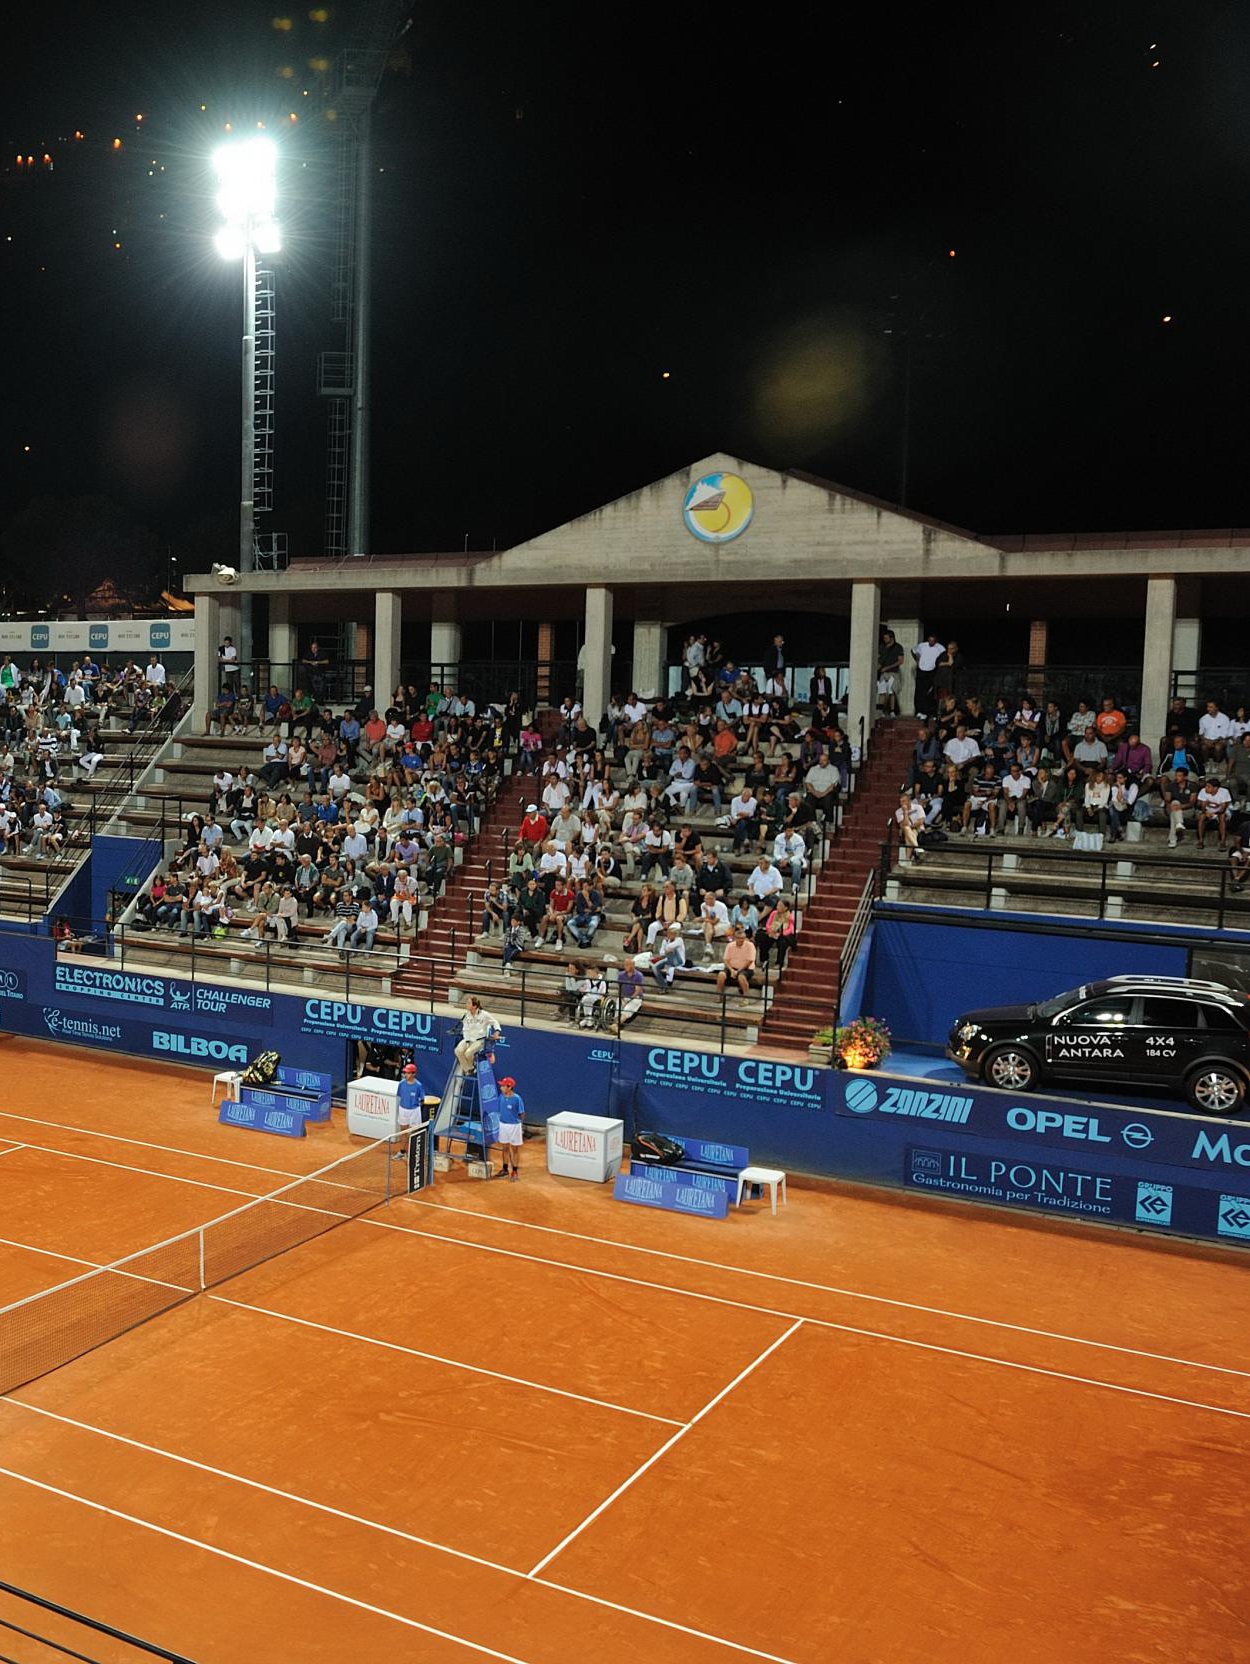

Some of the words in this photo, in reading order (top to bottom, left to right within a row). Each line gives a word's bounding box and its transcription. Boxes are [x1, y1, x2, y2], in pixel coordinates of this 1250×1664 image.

[56, 966, 164, 996] ELECTRONICS
[58, 984, 111, 996] SHOPPING
[170, 1001, 190, 1011] ATP
[197, 988, 270, 1008] CHALLENGER
[197, 999, 226, 1013] TOUR
[50, 1014, 121, 1038] e-tennis.net
[306, 999, 362, 1024] CEPU
[373, 1008, 431, 1034] CEPU
[153, 1031, 247, 1063] BILBOA
[1055, 1036, 1111, 1045] NUOVA
[1146, 1037, 1174, 1046] 4X4
[591, 1050, 614, 1059] CEPU
[1059, 1048, 1124, 1058] ANTARA
[649, 1048, 719, 1077] CEPU
[738, 1061, 814, 1091] CEPU
[355, 1093, 390, 1115] LAURETANA
[1006, 1107, 1111, 1143] OPEL
[555, 1131, 596, 1152] LAURETANA
[701, 1144, 734, 1161] LAURETANA
[950, 1155, 977, 1180] IL
[990, 1161, 1112, 1201] PONTE
[1138, 1181, 1173, 1192] GRUPPO
[625, 1177, 663, 1199] LAURETANA
[676, 1187, 716, 1209] LAURETANA
[912, 1172, 1002, 1197] Gastronomia
[1006, 1189, 1031, 1202] per
[1033, 1191, 1111, 1214] Tradizione
